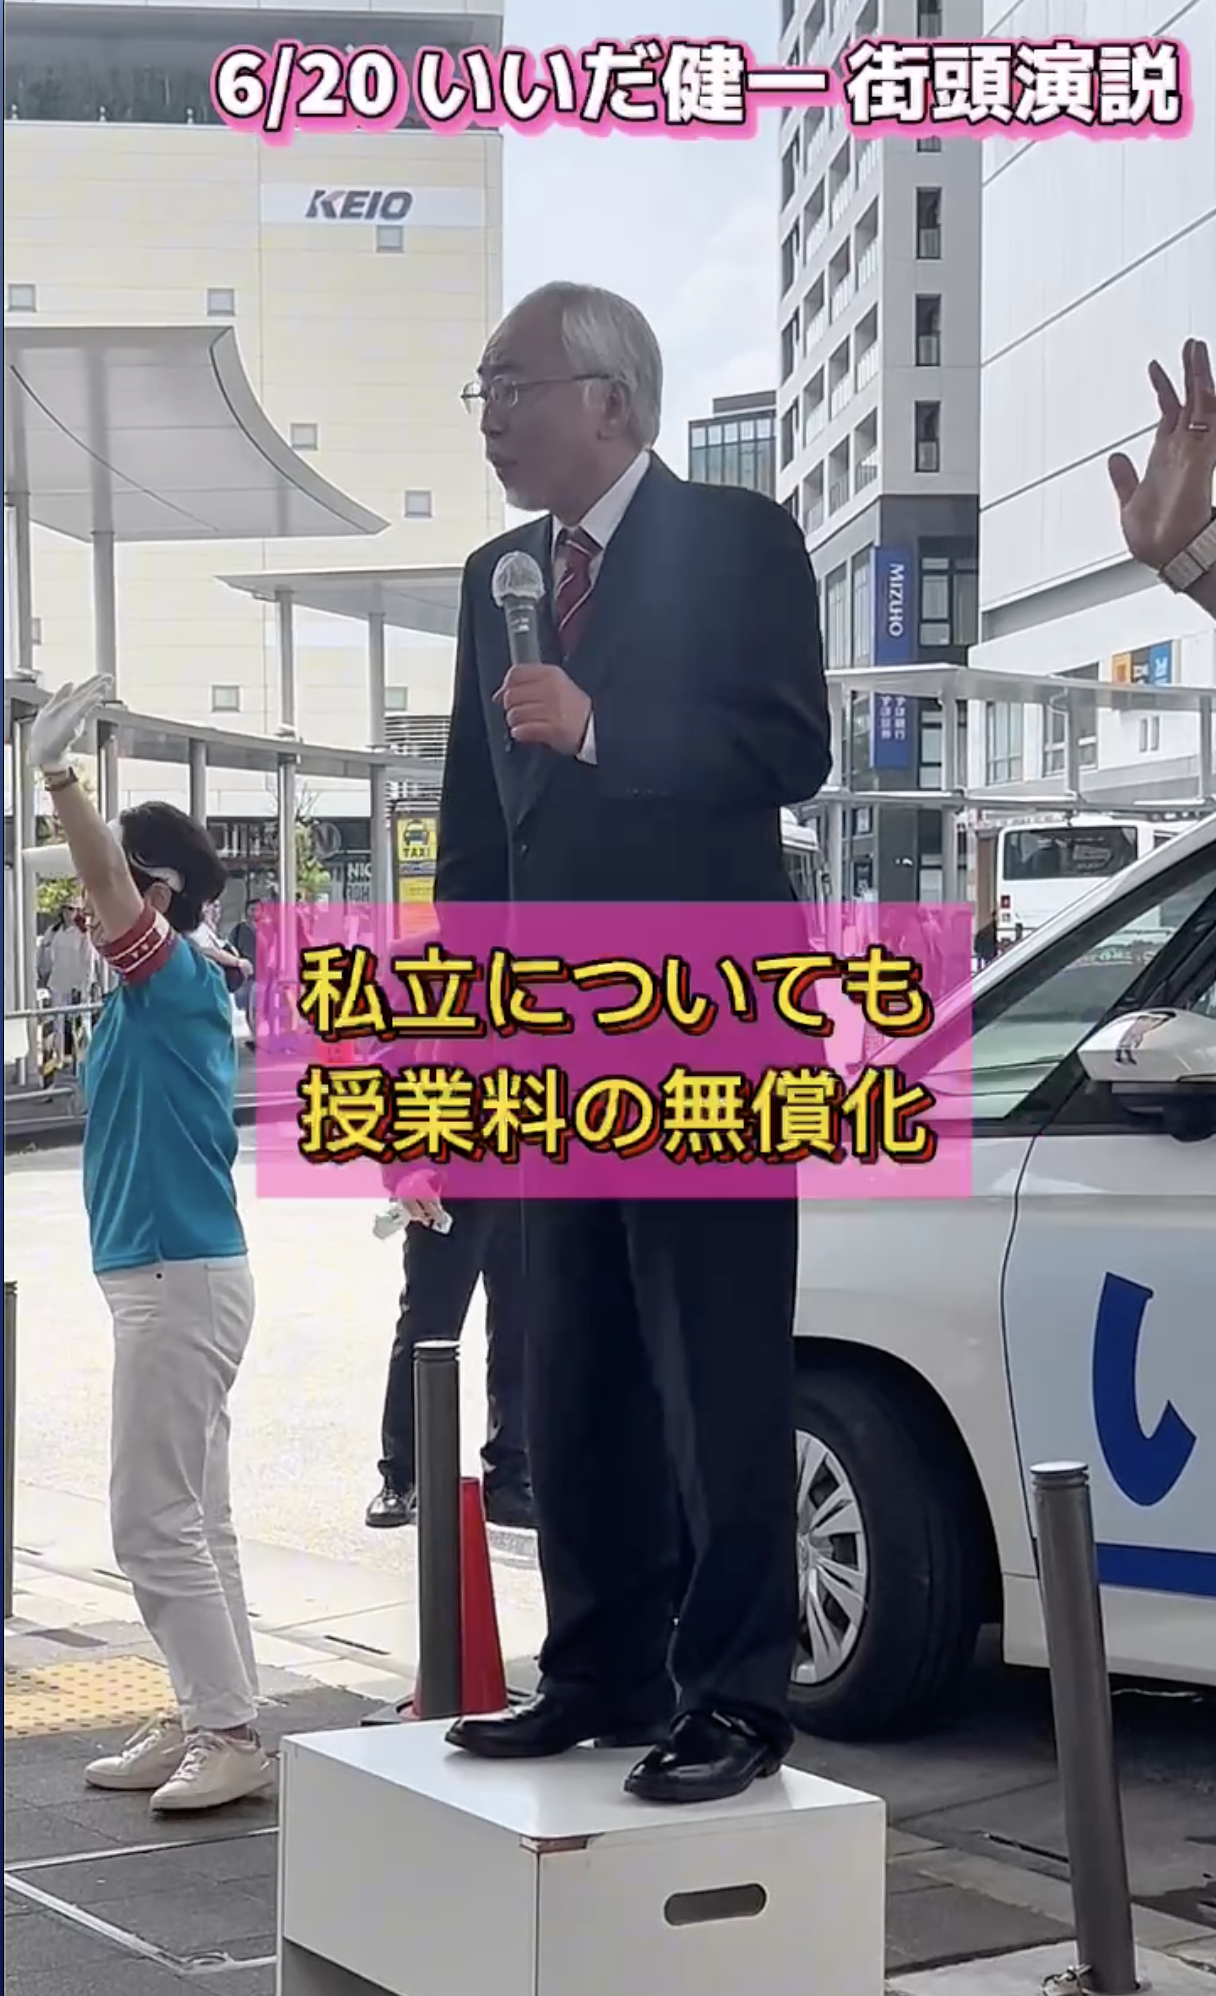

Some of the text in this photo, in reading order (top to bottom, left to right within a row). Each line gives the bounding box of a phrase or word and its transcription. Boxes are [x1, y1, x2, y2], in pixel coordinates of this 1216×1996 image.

[304, 189, 414, 221] KEIO
[888, 562, 905, 637] MIZUHO
[402, 848, 431, 858] TAXI
